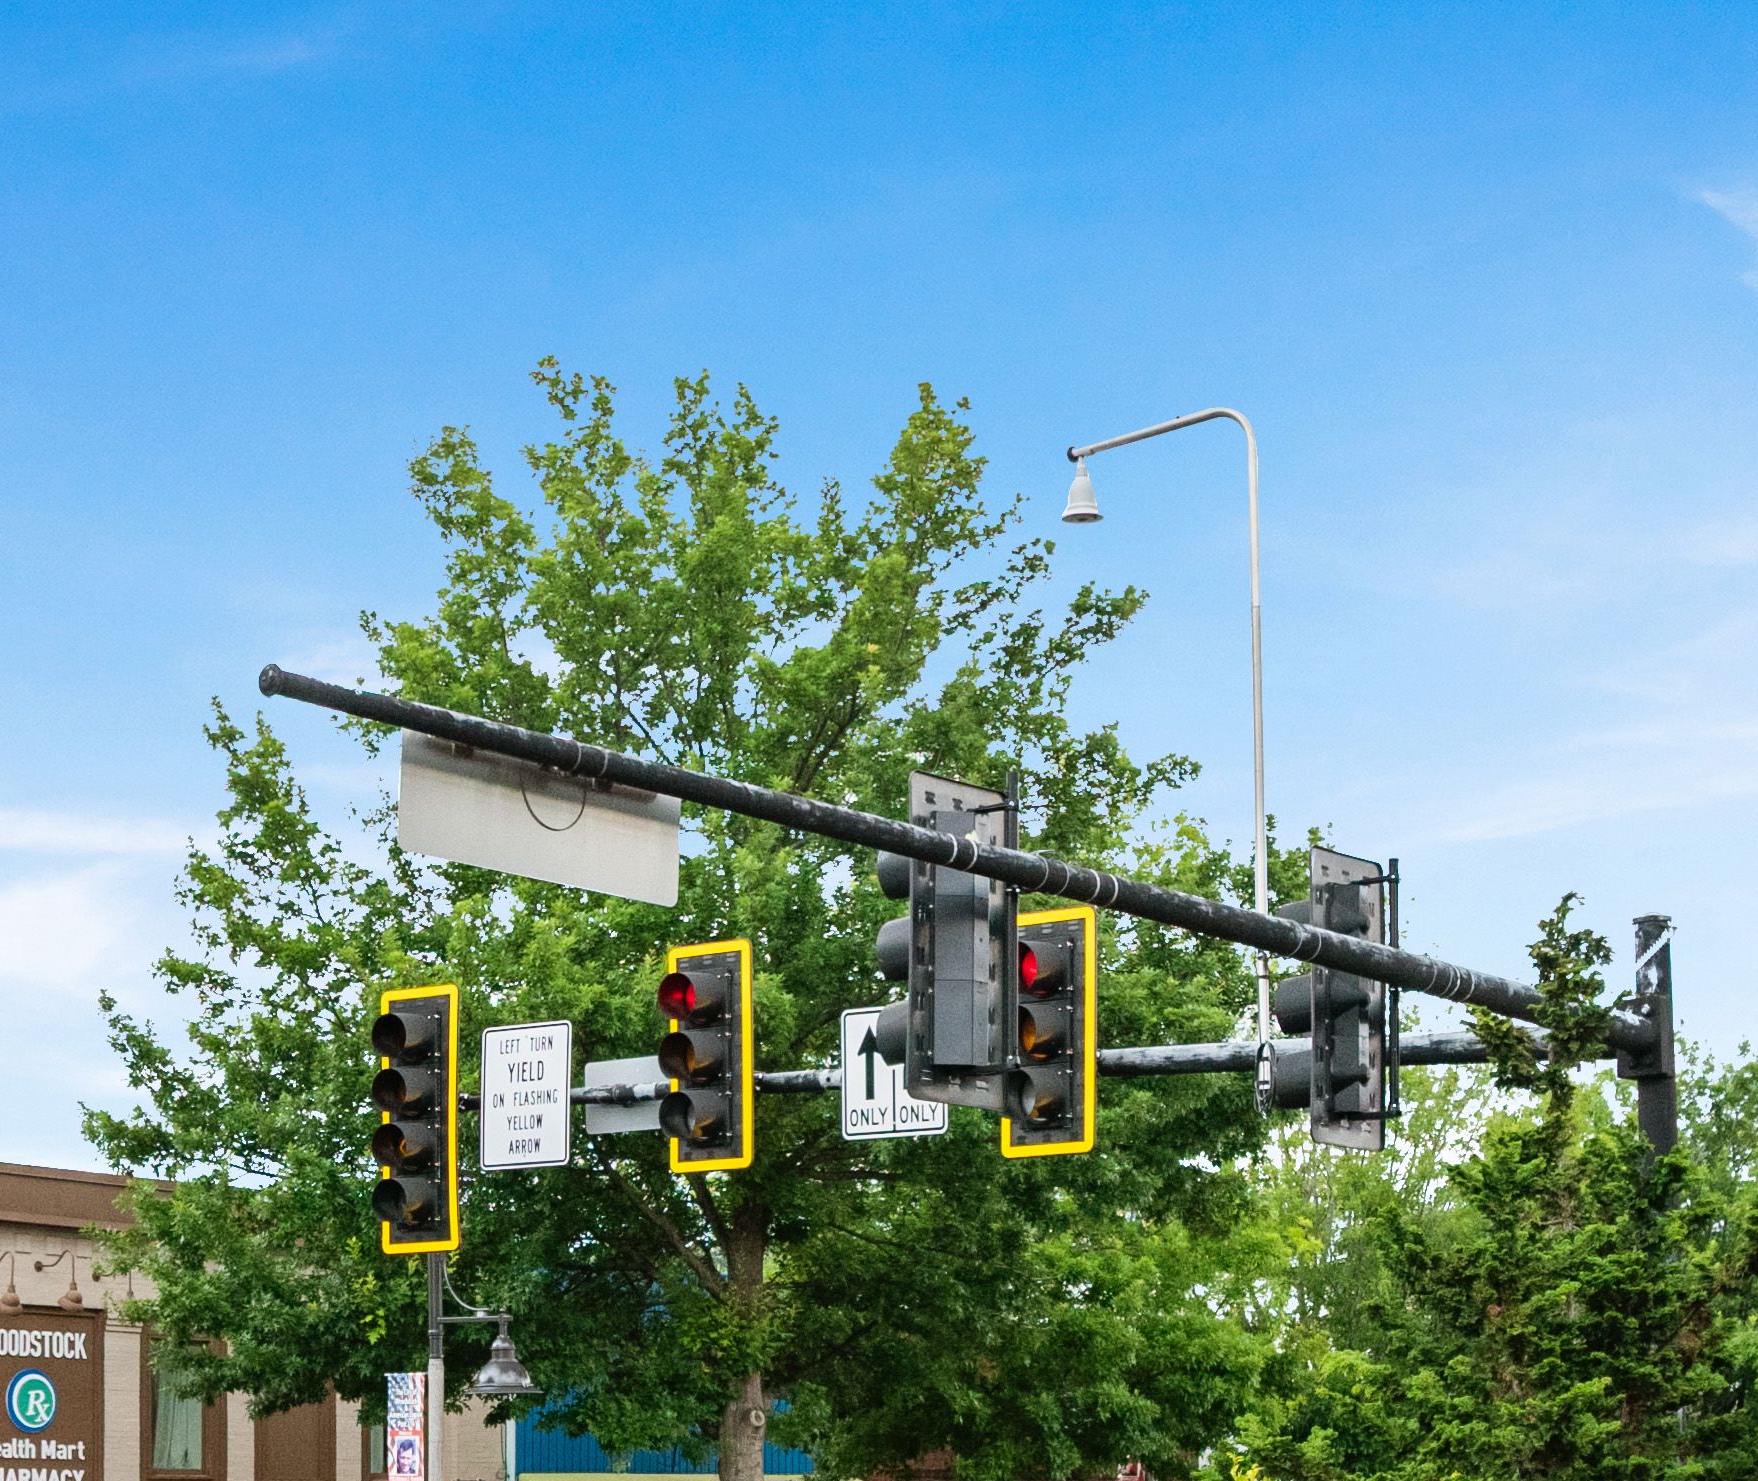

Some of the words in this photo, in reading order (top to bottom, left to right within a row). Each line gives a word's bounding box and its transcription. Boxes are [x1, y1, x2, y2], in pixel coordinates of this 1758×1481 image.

[499, 1038, 520, 1055] LEFT
[530, 1035, 554, 1052] TURN
[508, 1060, 545, 1083] YIELD
[492, 1093, 505, 1109] ON
[513, 1088, 558, 1107] FLASHING
[507, 1114, 544, 1131] YELLOW
[849, 1106, 888, 1127] ONLY
[899, 1103, 938, 1124] ONLY
[508, 1138, 541, 1155] ARROW
[40, 1439, 86, 1461] Mart
